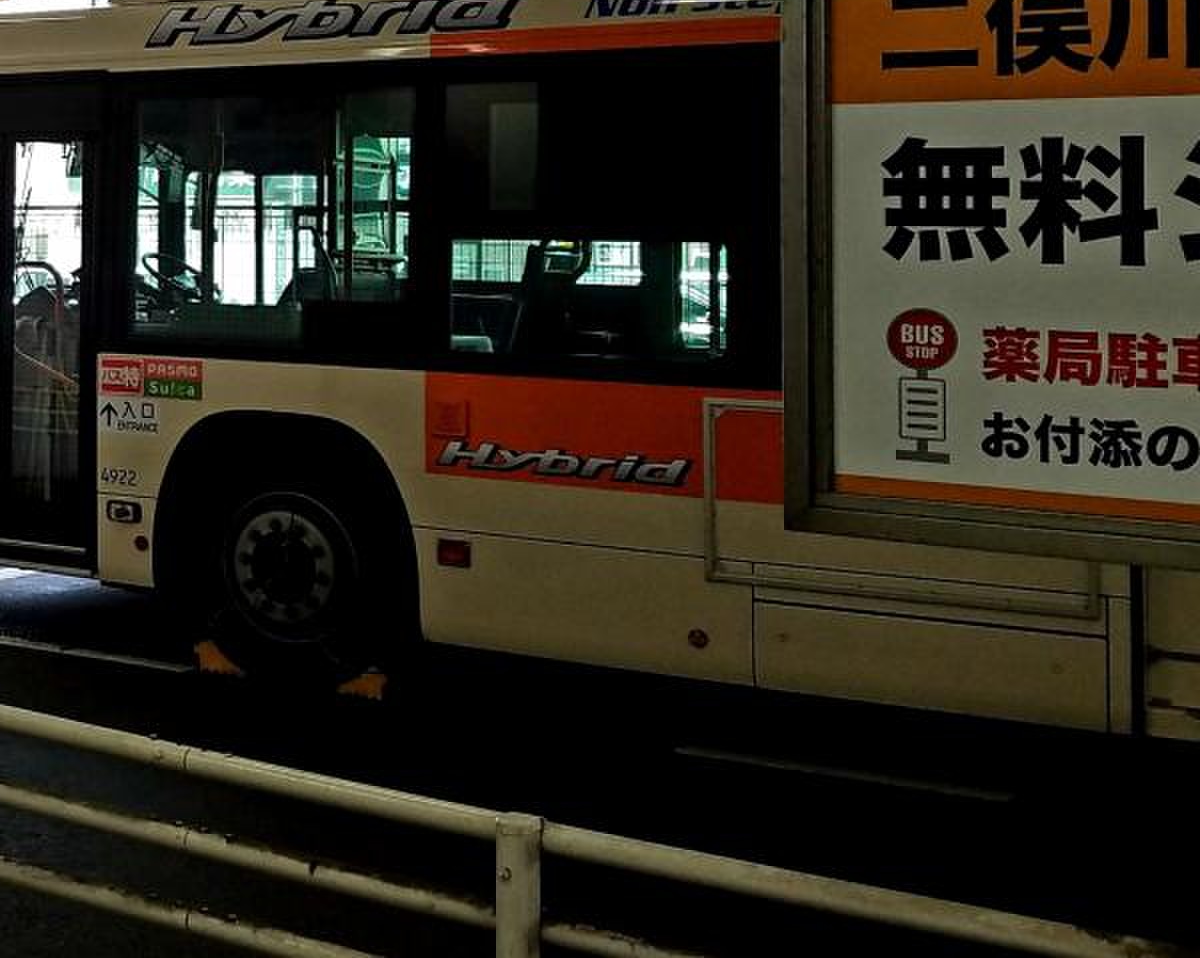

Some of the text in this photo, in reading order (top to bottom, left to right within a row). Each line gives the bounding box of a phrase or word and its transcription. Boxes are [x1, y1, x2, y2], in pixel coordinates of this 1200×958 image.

[881, 135, 1200, 266] 無料
[899, 323, 946, 345] BUS
[904, 345, 940, 360] STOP
[147, 363, 199, 378] PASMO
[147, 379, 197, 396] Suica
[122, 402, 155, 419] 入口
[981, 412, 1200, 472] お付添の
[437, 439, 690, 485] Hybrid
[100, 467, 137, 486] 4922
